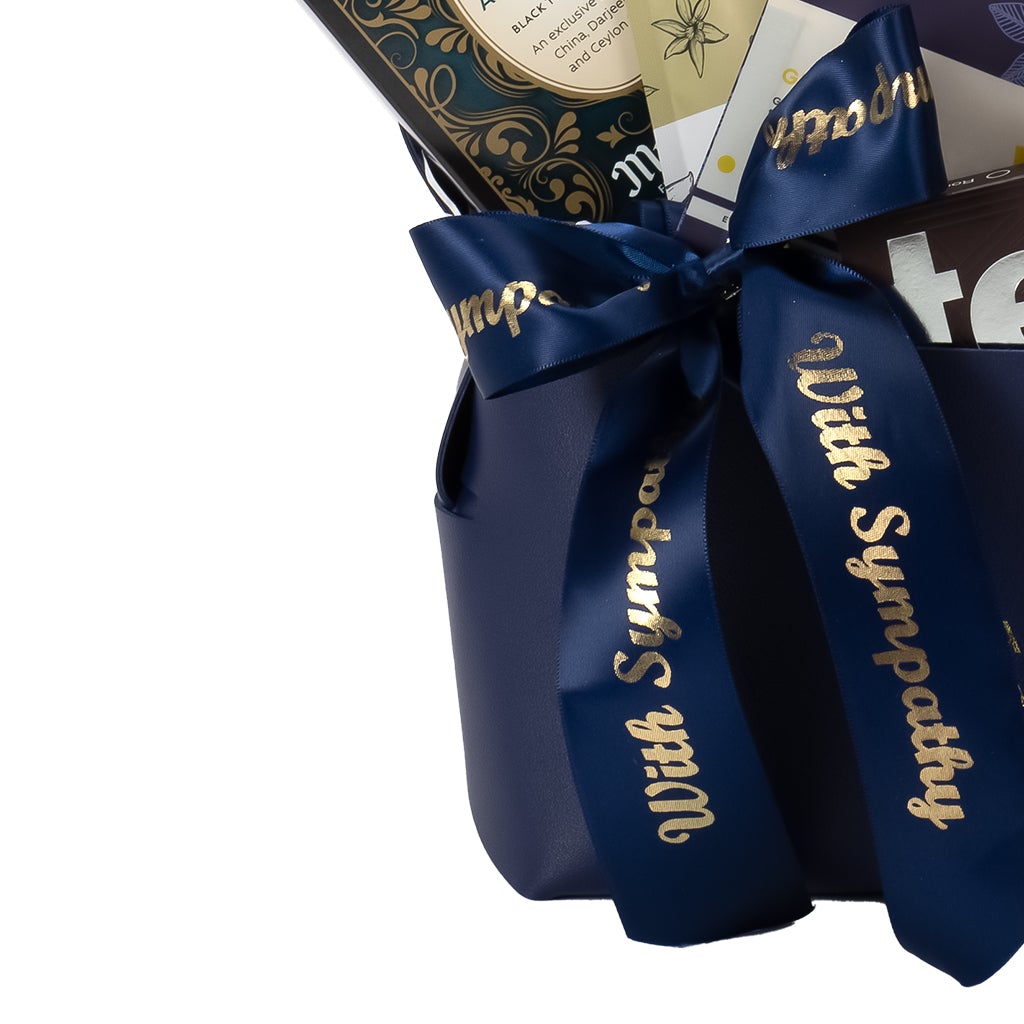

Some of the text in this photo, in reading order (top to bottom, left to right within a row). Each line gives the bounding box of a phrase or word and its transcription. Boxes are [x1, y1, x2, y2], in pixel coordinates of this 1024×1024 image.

[511, 2, 547, 34] BLACK
[532, 39, 549, 55] An
[554, 29, 591, 60] China,
[568, 19, 630, 72] and Ceylon
[787, 331, 975, 830] With Sympathy
[624, 704, 716, 844] With
